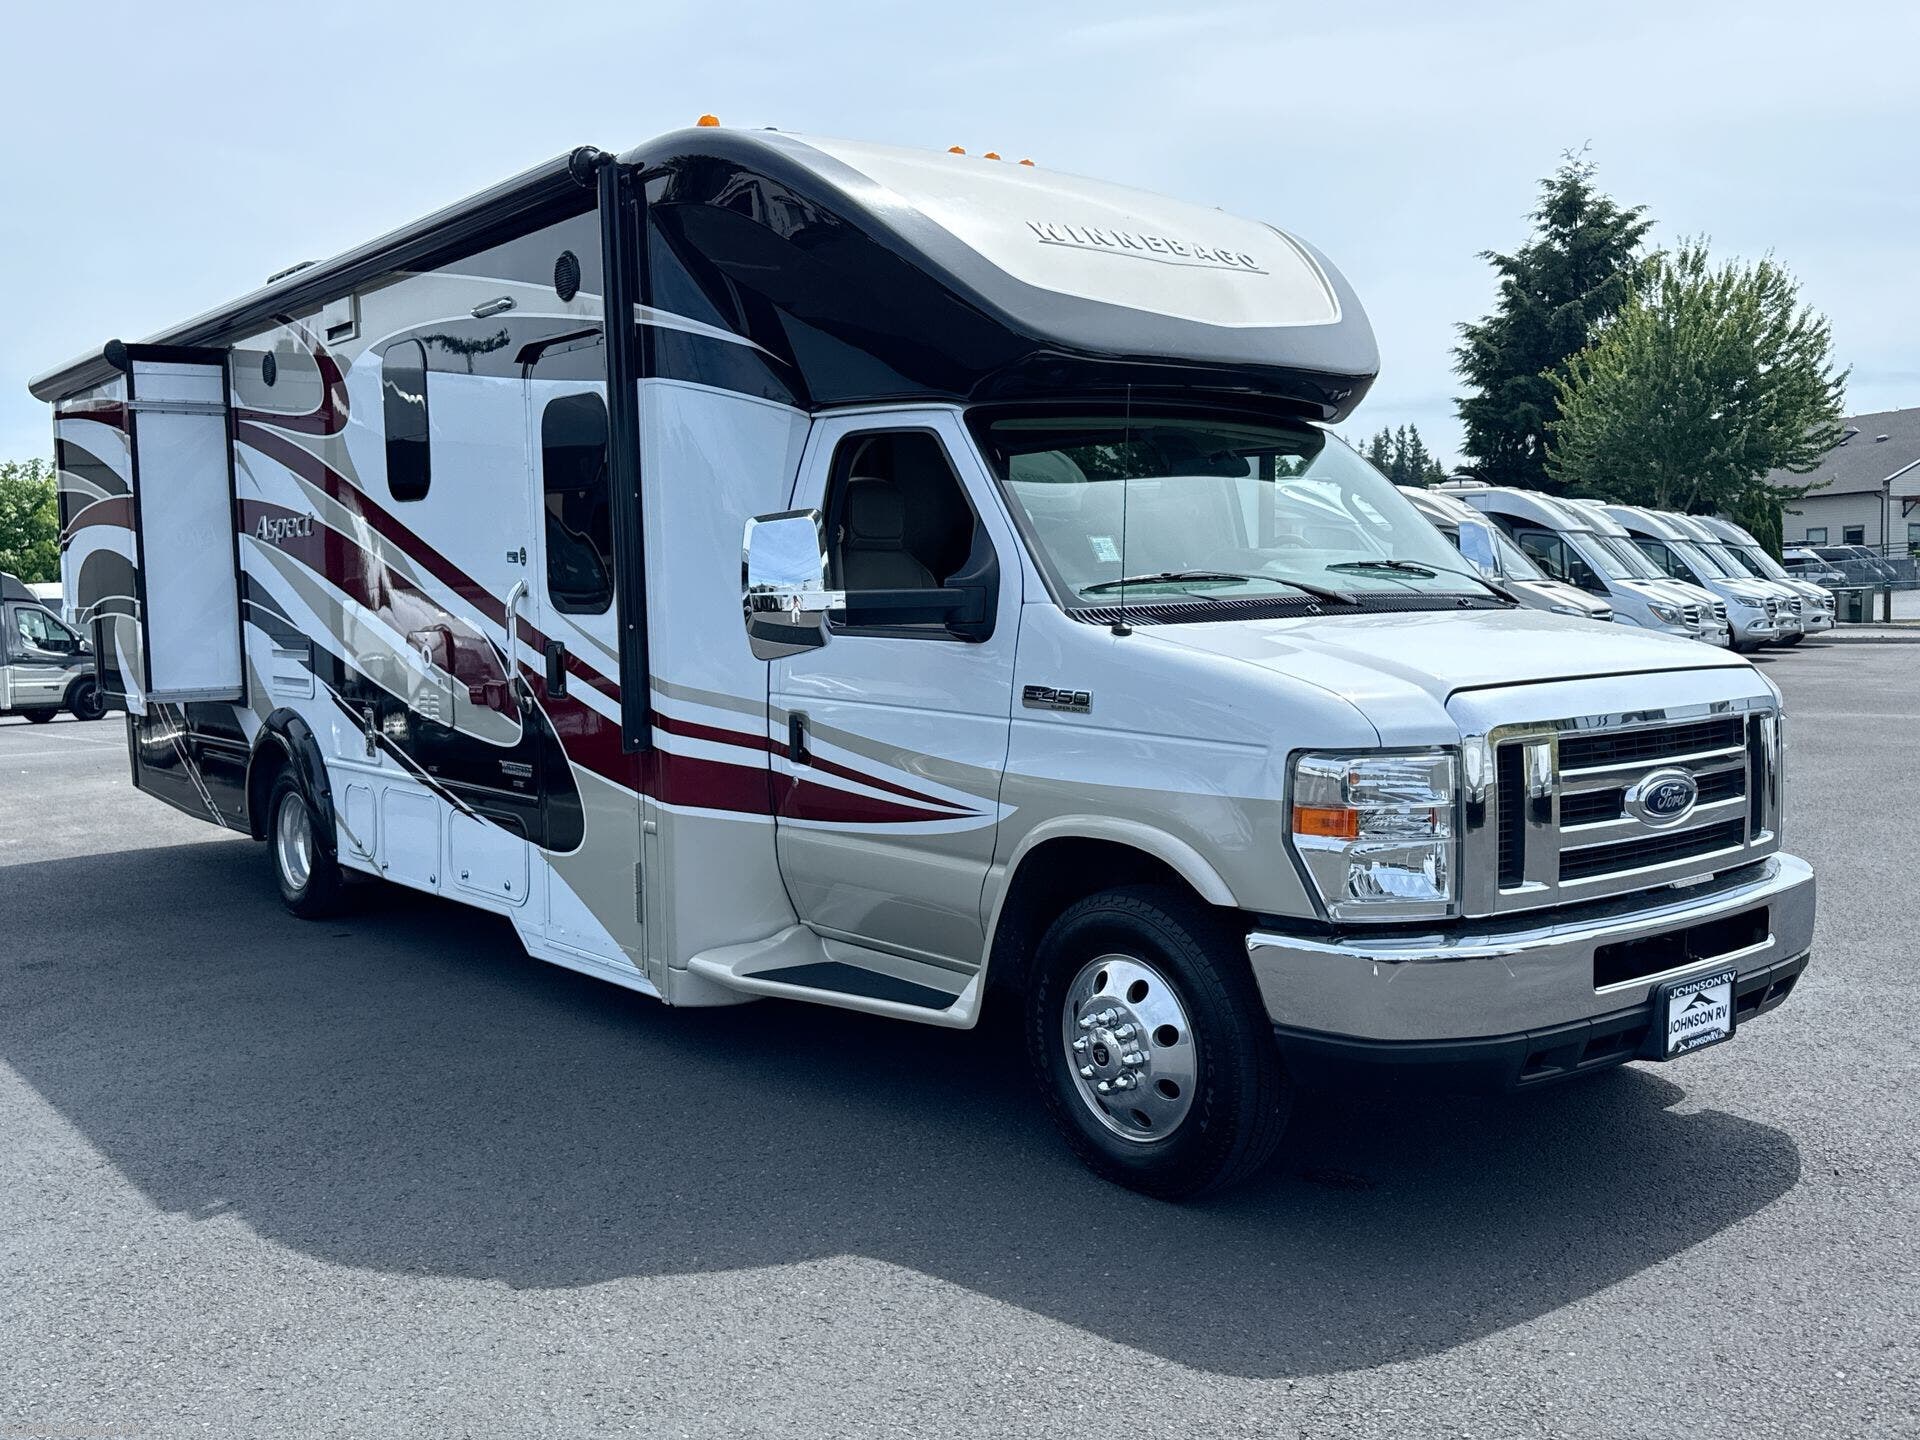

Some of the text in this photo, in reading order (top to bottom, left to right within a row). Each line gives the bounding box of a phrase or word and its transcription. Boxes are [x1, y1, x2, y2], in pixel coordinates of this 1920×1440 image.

[1025, 220, 1260, 270] WINNEBAGO
[256, 512, 315, 544] Aspect
[1657, 785, 1687, 810] Ford
[1670, 971, 1737, 999] JOHNSON RV
[1669, 1009, 1714, 1034] JOHNSON
[1715, 1005, 1728, 1020] RV
